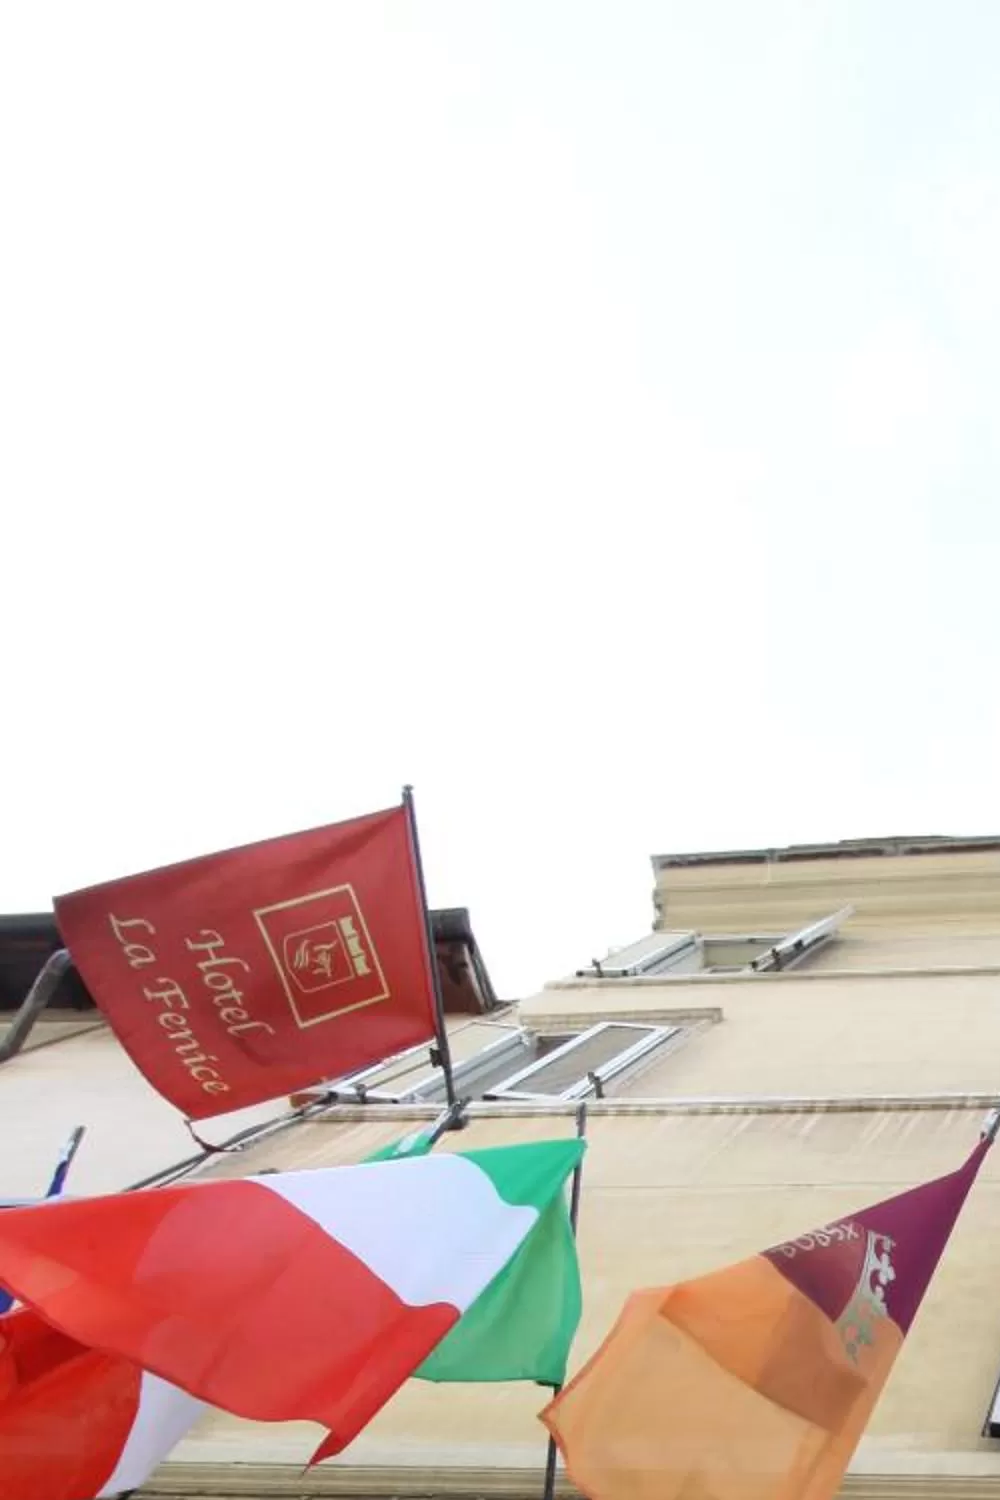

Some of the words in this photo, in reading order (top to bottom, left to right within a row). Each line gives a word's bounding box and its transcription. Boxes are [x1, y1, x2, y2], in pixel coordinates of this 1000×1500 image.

[108, 912, 156, 969] La
[143, 976, 231, 1095] Fenice
[185, 928, 274, 1038] Hotel
